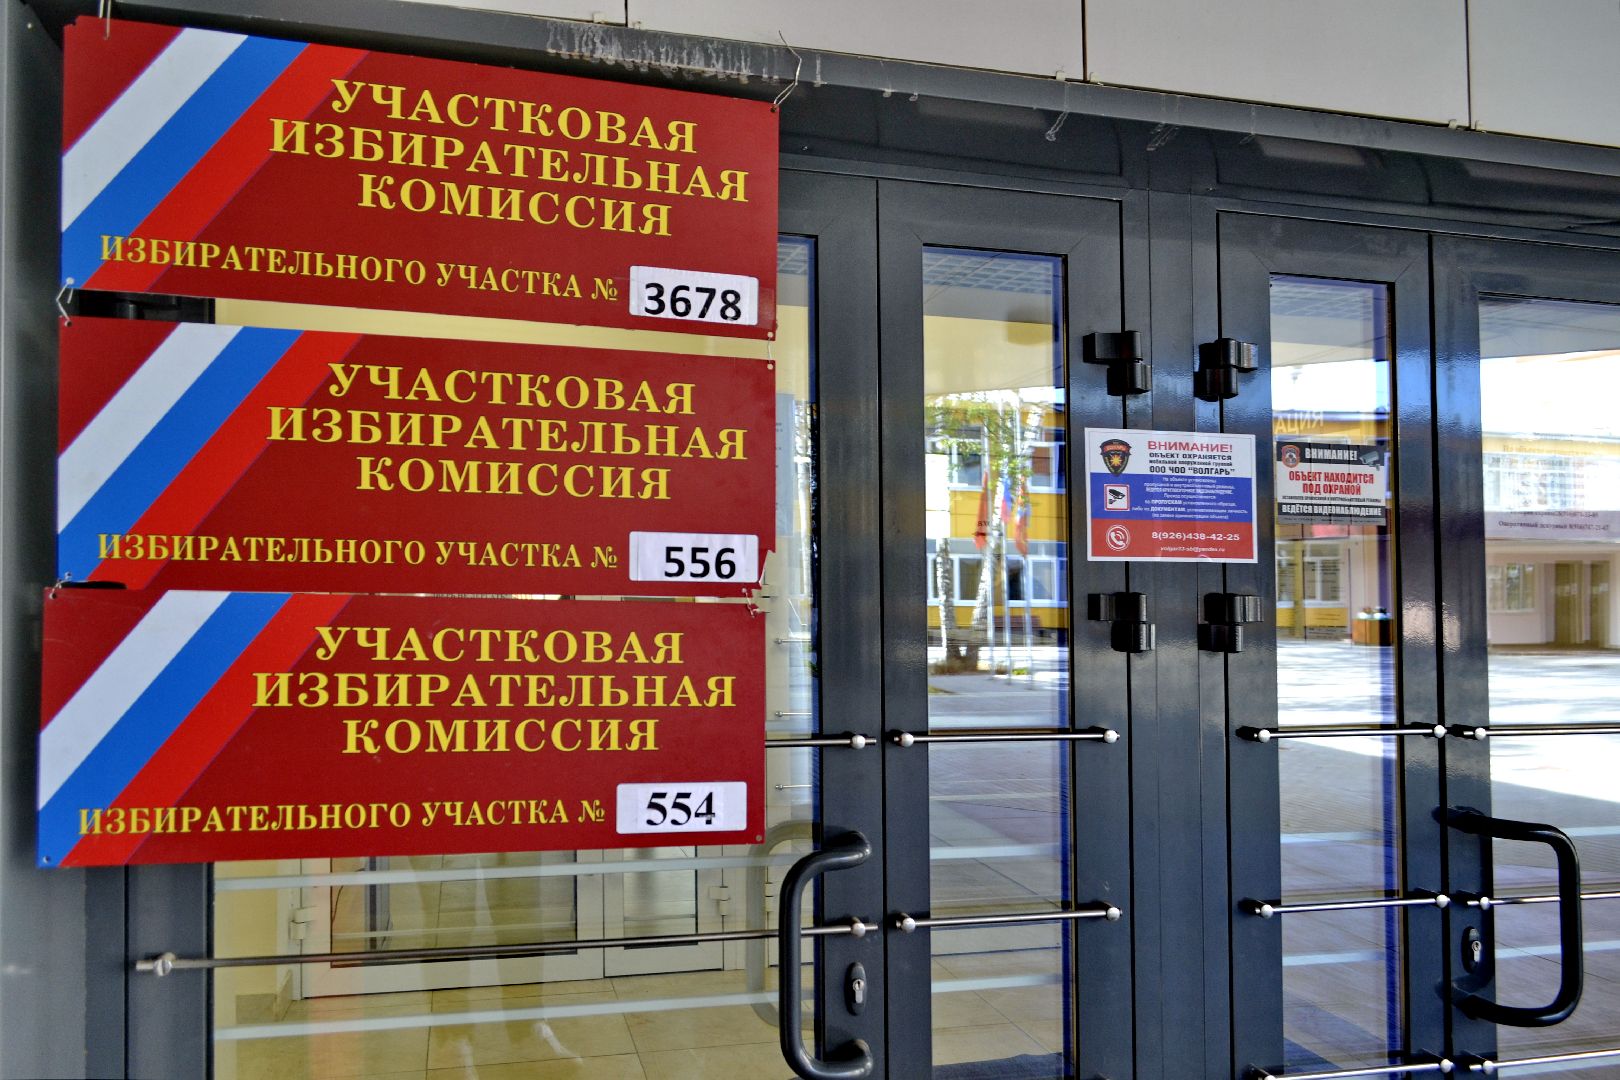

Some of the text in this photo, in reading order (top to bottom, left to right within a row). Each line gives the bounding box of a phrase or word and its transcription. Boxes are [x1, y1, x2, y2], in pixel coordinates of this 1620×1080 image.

[330, 79, 697, 154] УЧАСТКОВАЯ
[269, 118, 749, 203] ИЗБИРАТЕЛЬНАЯ
[357, 173, 673, 236] КОМИССИЯ
[100, 234, 742, 322] ИЗБИРАТЕЛЬНОГО УЧАСТКА № 3678
[328, 362, 695, 415] УЧАСТКОВАЯ
[266, 406, 748, 460] ИЗБИРАТЕЛЬНАЯ
[1147, 440, 1233, 453] ВНИМАНИЕ!
[1149, 465, 1166, 473] ООО
[1168, 466, 1186, 474] ЧОО
[1182, 453, 1232, 461] ОХРАНЯЕТСЯ
[1304, 447, 1358, 461] ВНИМАНИЕ!
[356, 456, 672, 500] КОМИССИЯ
[1288, 470, 1374, 484] ОБЪЕКТ НАХОДИТСЯ
[1302, 483, 1361, 495] ПОД ОХРАНОЙ
[1313, 505, 1382, 517] ВИДЕОНАБЛЮДЕНИЕ
[1151, 530, 1240, 542] 8(926)438-42-25
[97, 534, 737, 581] ИЗБИРАТЕЛЬНОГО УЧАСТКА № 556
[314, 626, 684, 664] УЧАСТКОВАЯ
[252, 672, 737, 708] ИЗБИРАТЕЛЬНАЯ
[342, 718, 658, 754] КОМИССИЯ
[78, 791, 717, 836] ИЗБИРАТЕЛЬНОГО УЧАСТКА № 554
